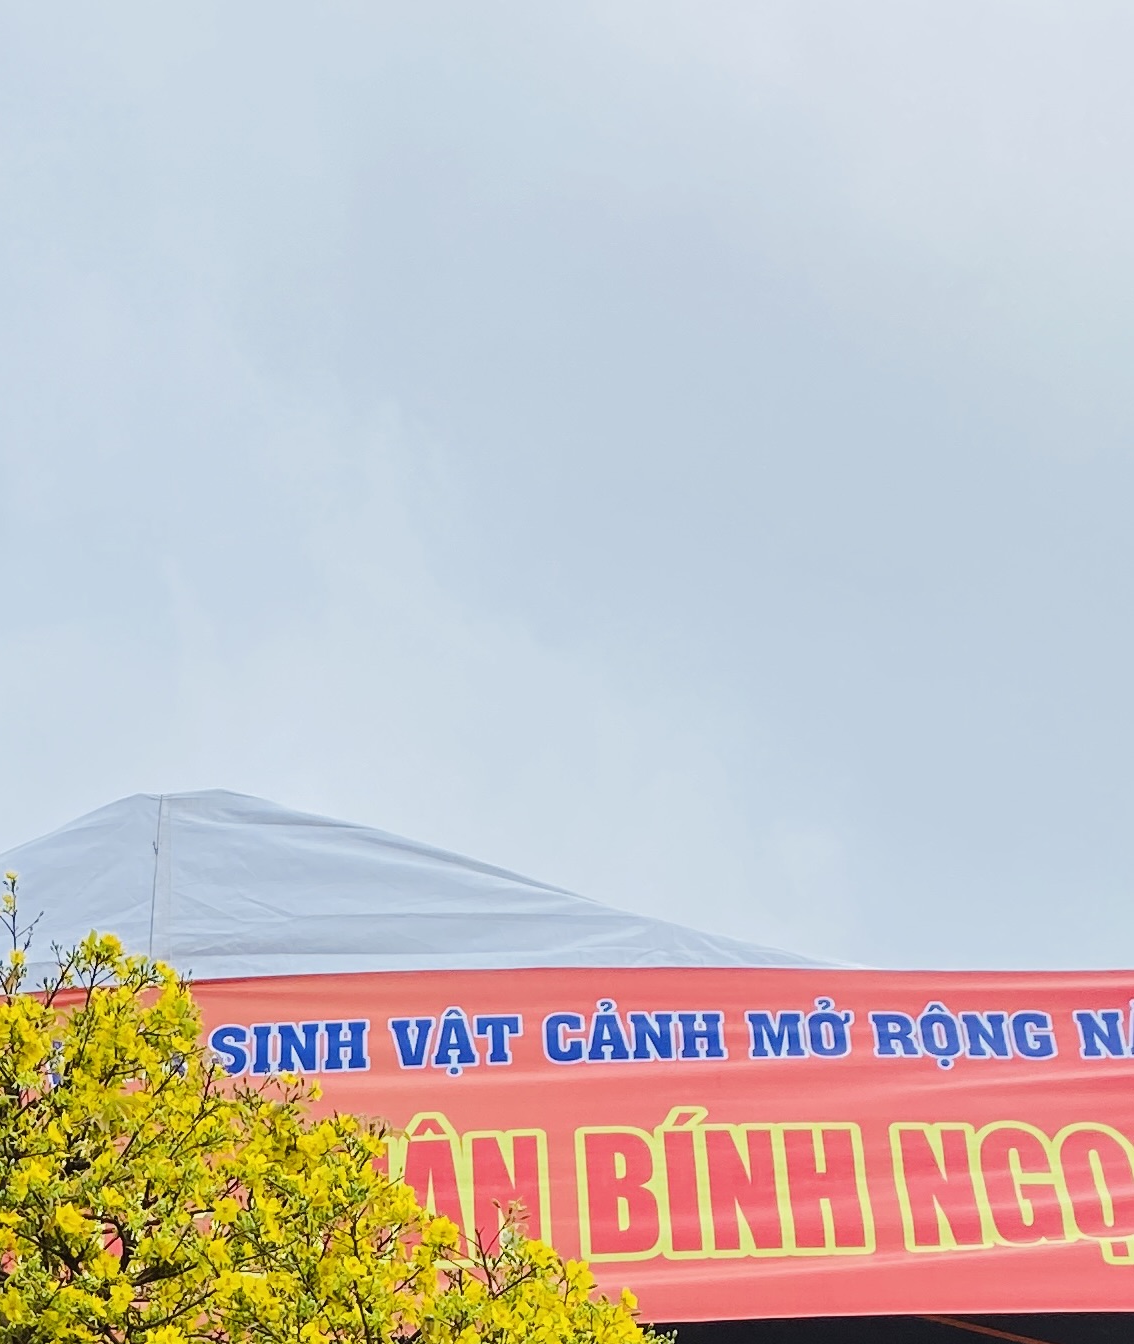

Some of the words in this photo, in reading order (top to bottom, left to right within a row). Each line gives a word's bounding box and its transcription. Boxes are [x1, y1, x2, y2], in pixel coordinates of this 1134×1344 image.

[209, 1019, 370, 1077] SINH
[388, 1007, 523, 1076] VẬT
[542, 998, 728, 1062] CẢNH
[744, 996, 854, 1060] MỞ
[868, 1001, 1058, 1070] RỘNG
[381, 1111, 552, 1270] ÂN
[574, 1106, 875, 1262] BÍNH
